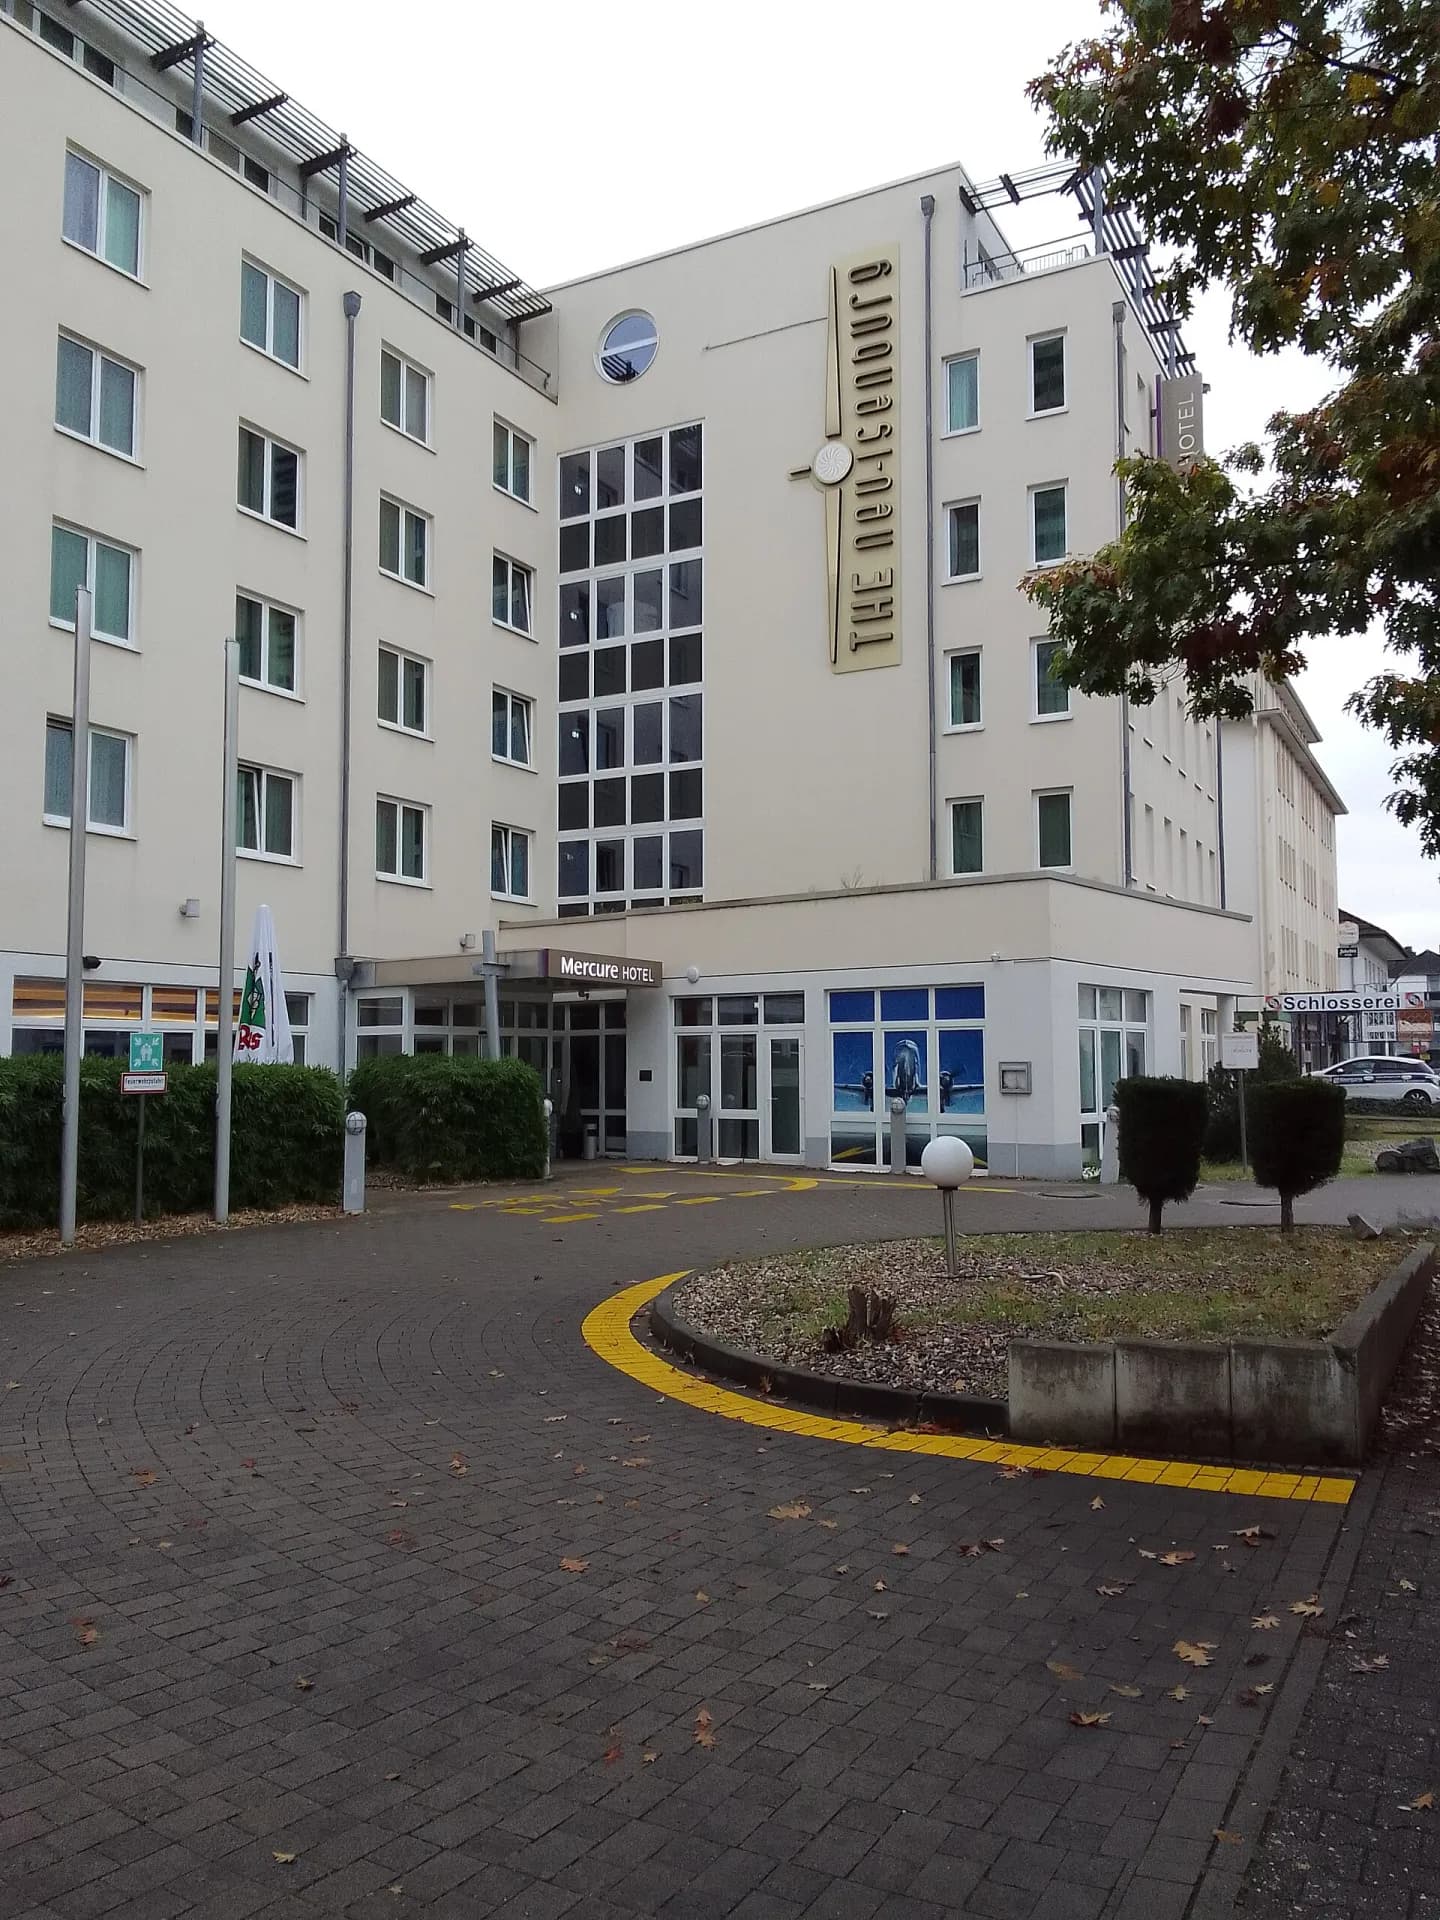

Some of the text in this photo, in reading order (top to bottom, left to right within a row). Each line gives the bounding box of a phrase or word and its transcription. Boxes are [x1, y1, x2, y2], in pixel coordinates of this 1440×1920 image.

[849, 566, 894, 652] THE
[561, 956, 655, 982] Mercure HOTEL
[1283, 994, 1401, 1010] Schlosserei
